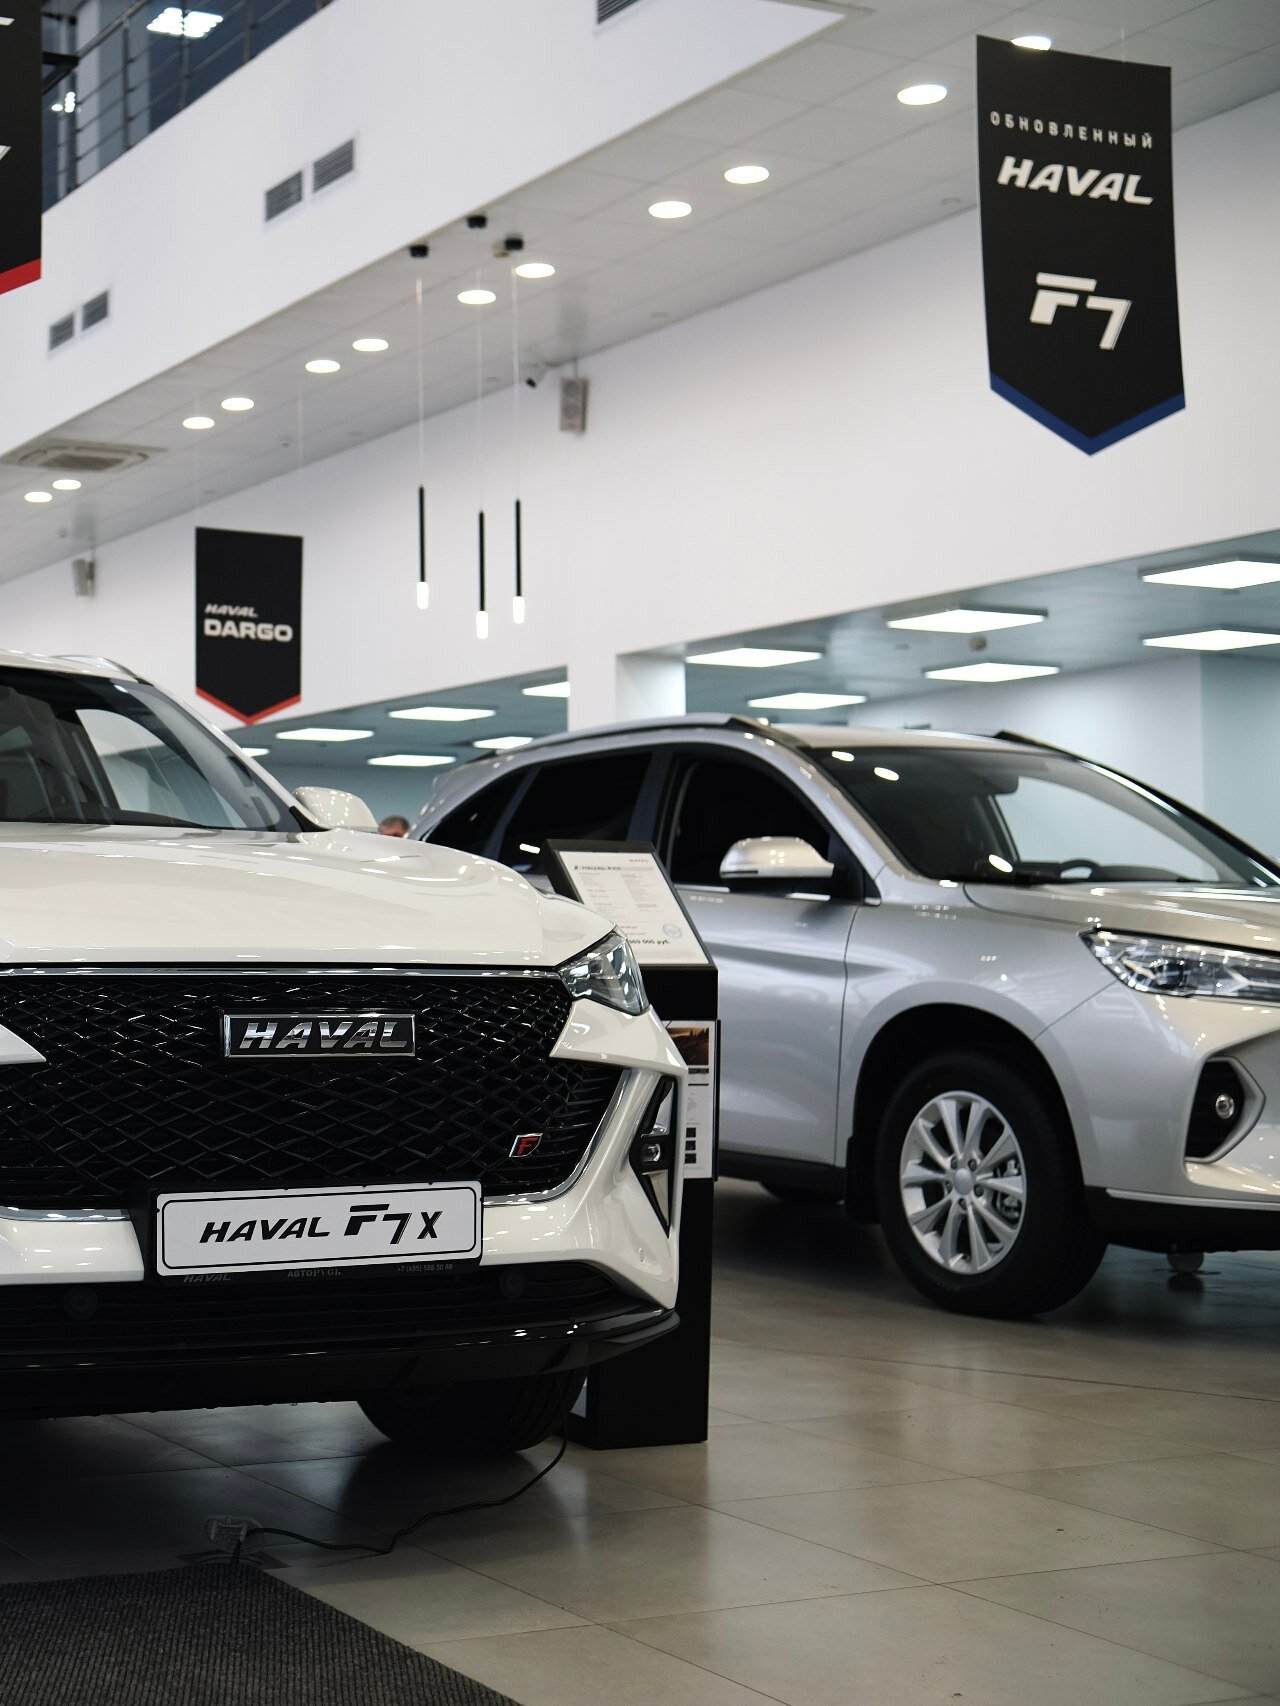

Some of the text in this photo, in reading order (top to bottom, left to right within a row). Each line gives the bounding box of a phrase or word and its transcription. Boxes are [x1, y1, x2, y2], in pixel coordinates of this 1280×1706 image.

[989, 110, 1154, 150] ОБНОВЛЕННЫЙ
[996, 155, 1154, 205] HAVAL
[1029, 271, 1132, 351] F7
[204, 603, 259, 618] HAVAL
[203, 618, 294, 643] DARGO
[238, 1021, 409, 1049] HAVAL
[198, 1216, 331, 1244] HAVAL
[183, 1274, 232, 1283] HAVAL
